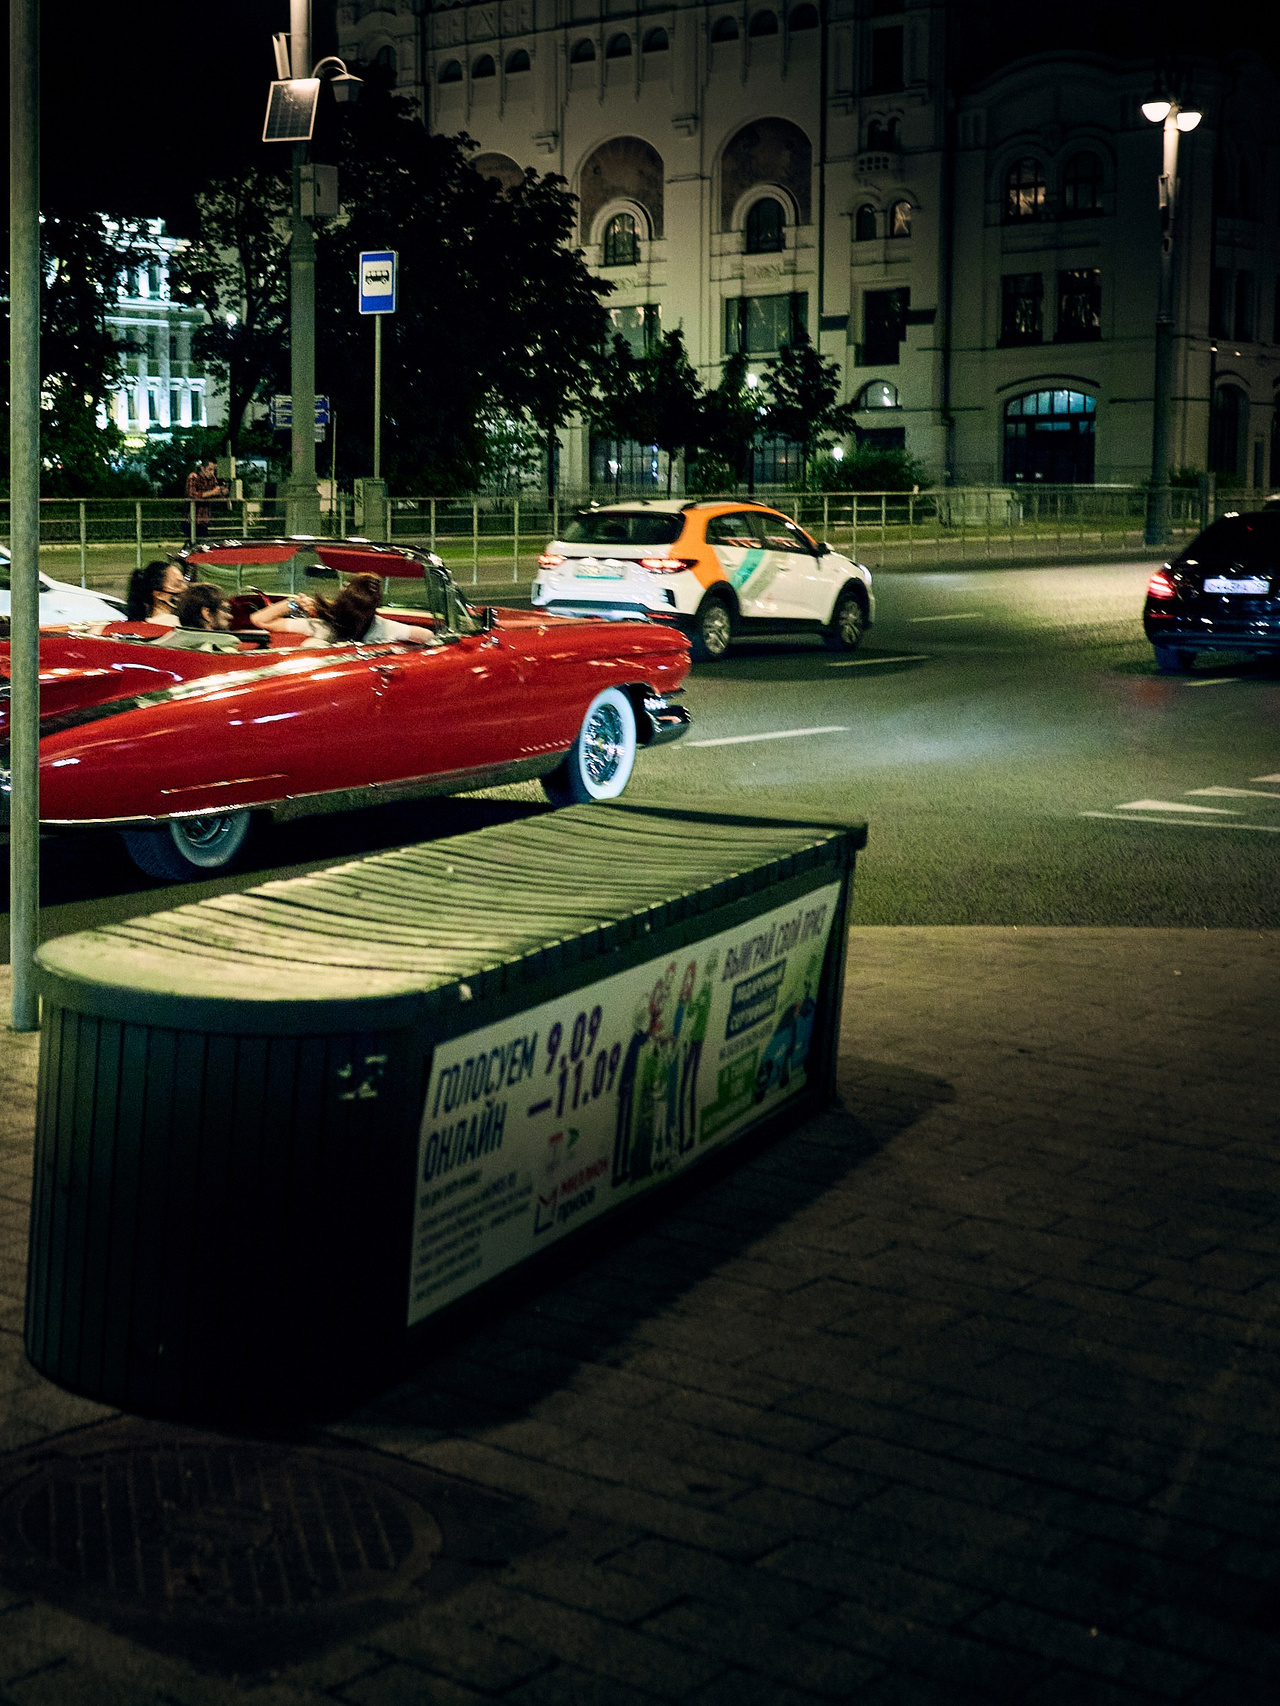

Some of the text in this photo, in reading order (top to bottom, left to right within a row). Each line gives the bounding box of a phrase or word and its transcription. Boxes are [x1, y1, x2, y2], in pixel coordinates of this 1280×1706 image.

[433, 1031, 538, 1119] ГОЛОСУЕМ
[546, 1005, 602, 1075] 9.09
[424, 1098, 507, 1181] ОНЛАЙН
